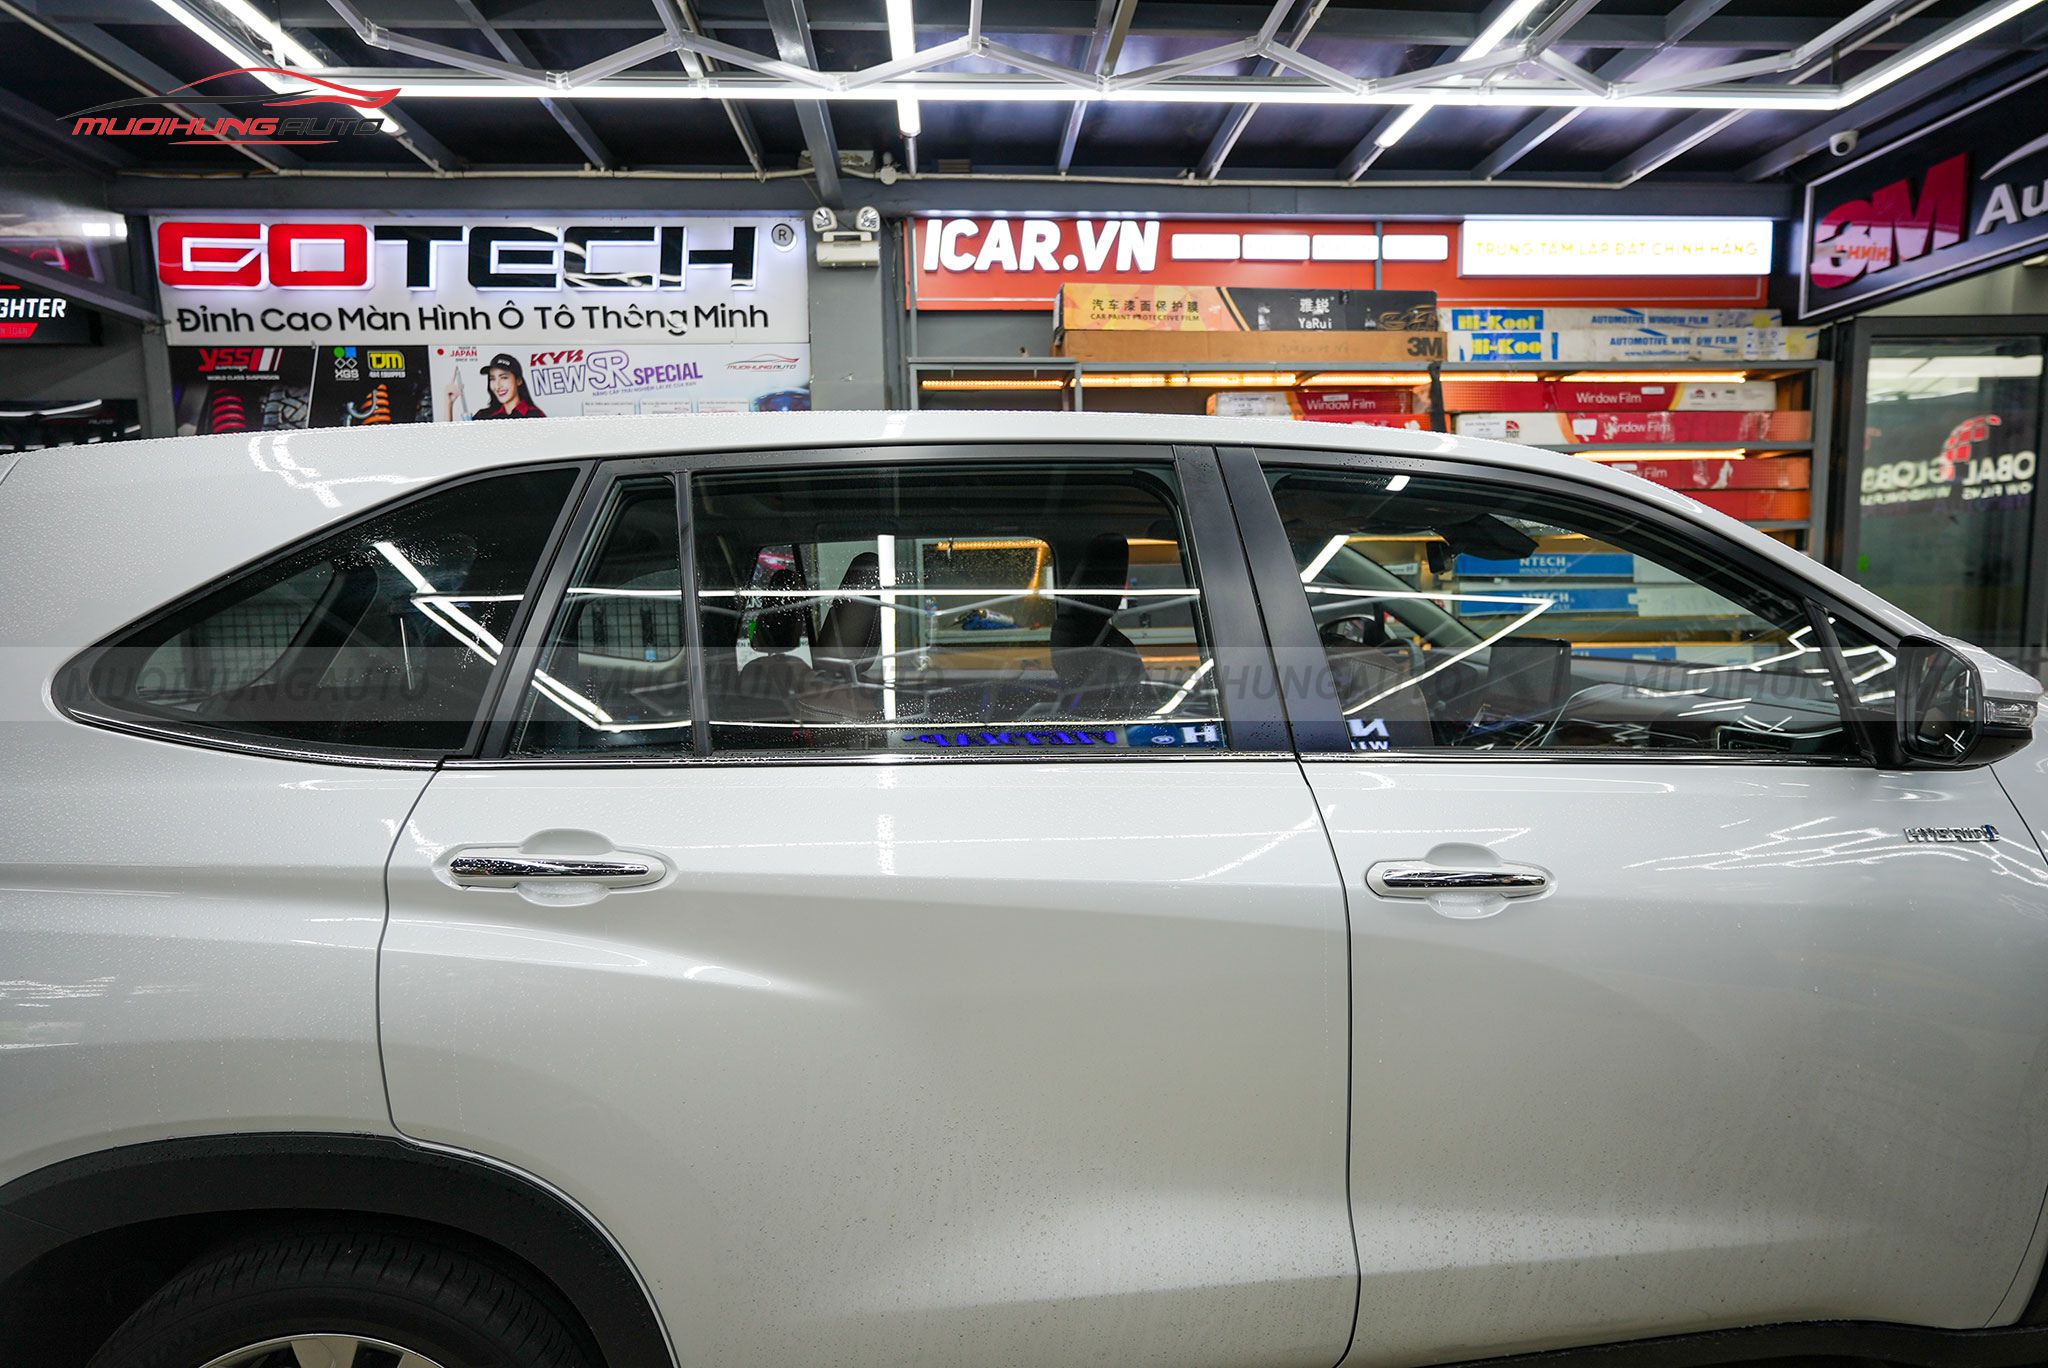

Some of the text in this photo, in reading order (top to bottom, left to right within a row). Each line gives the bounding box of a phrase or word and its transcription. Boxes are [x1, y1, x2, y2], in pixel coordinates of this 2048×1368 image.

[1810, 152, 1968, 289] 3M
[922, 218, 1161, 273] ICAR.VN
[158, 222, 759, 292] GOTECH
[177, 300, 769, 336] Đỉnh Cao Màn Hình Ô Tô Thông Minh
[1298, 317, 1333, 329] YaRui
[1591, 315, 1709, 325] AUTOMOTIVE WINDOW FILM
[1715, 335, 1738, 345] FILM
[1407, 337, 1443, 357] 3M
[450, 350, 478, 358] JAPAN
[530, 349, 584, 367] KYB
[531, 349, 704, 397] NEW SR SPECIAL
[1576, 392, 1642, 404] Window Film
[1306, 399, 1376, 410] Window Film
[1648, 422, 1671, 433] Film
[1644, 466, 1668, 477] Film
